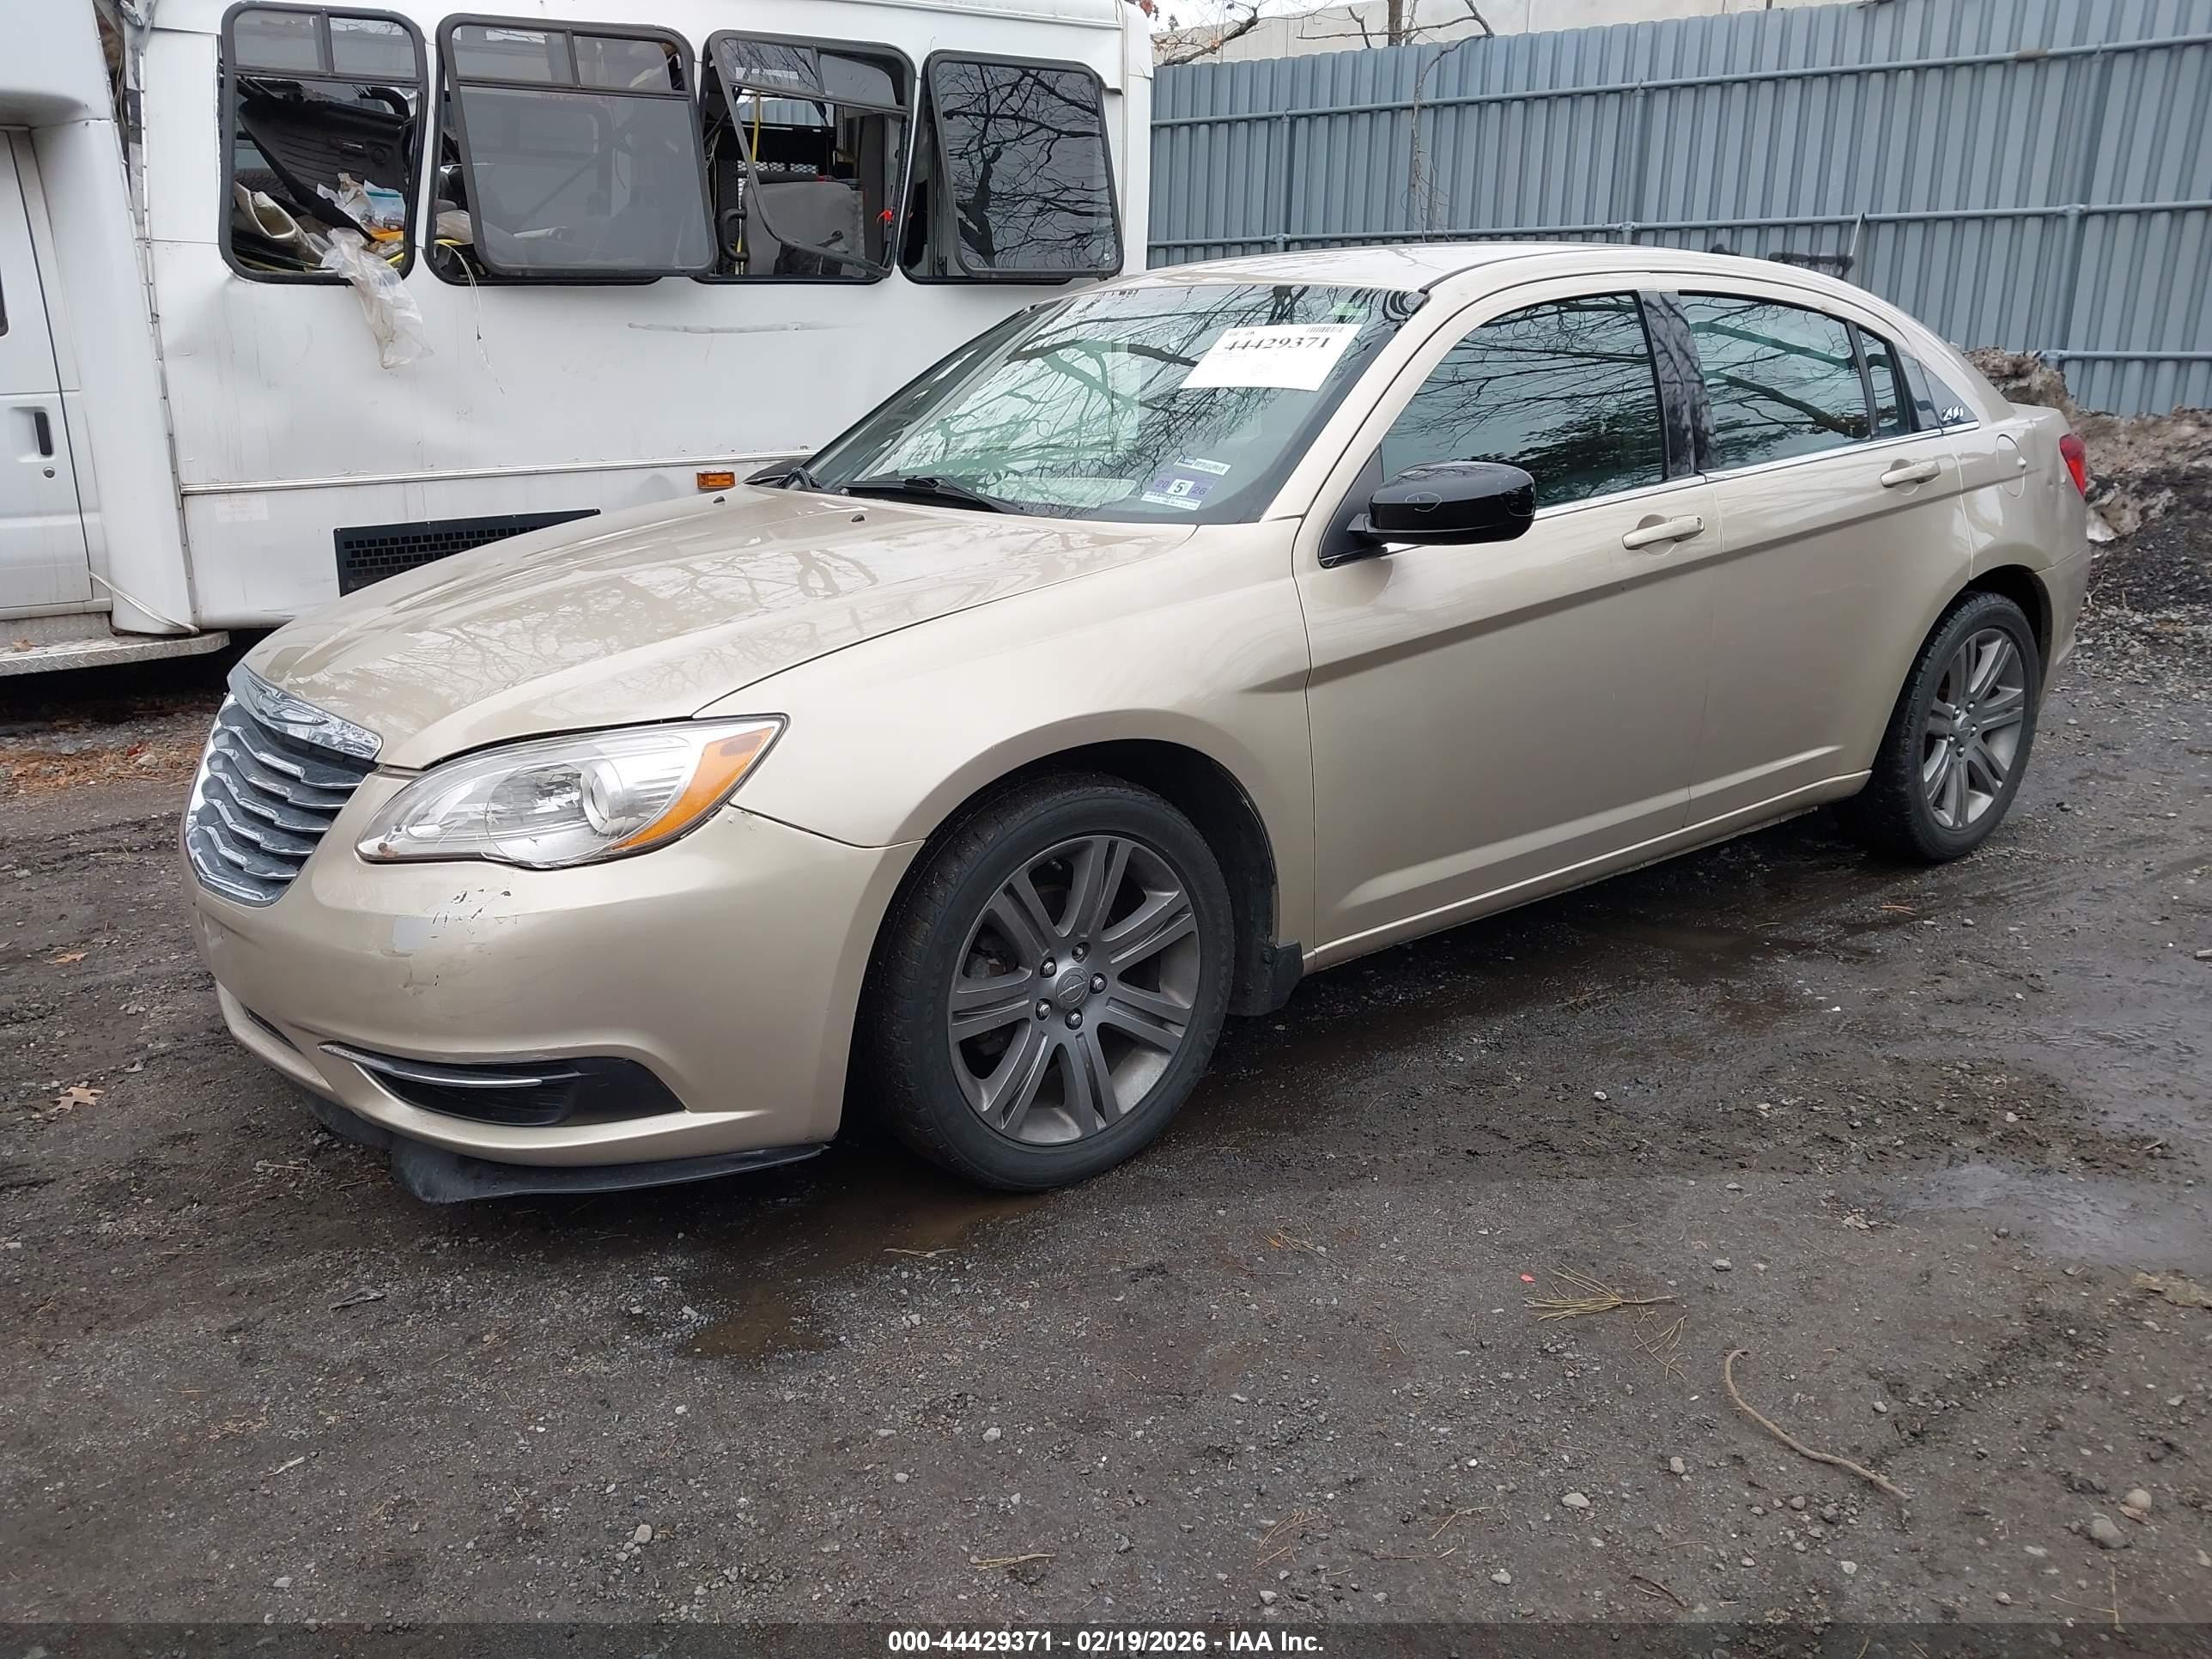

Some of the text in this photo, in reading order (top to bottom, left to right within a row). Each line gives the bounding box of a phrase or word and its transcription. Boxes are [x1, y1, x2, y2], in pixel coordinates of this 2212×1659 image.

[1224, 337, 1330, 350] 44429371
[1155, 480, 1207, 495] 20 5 26
